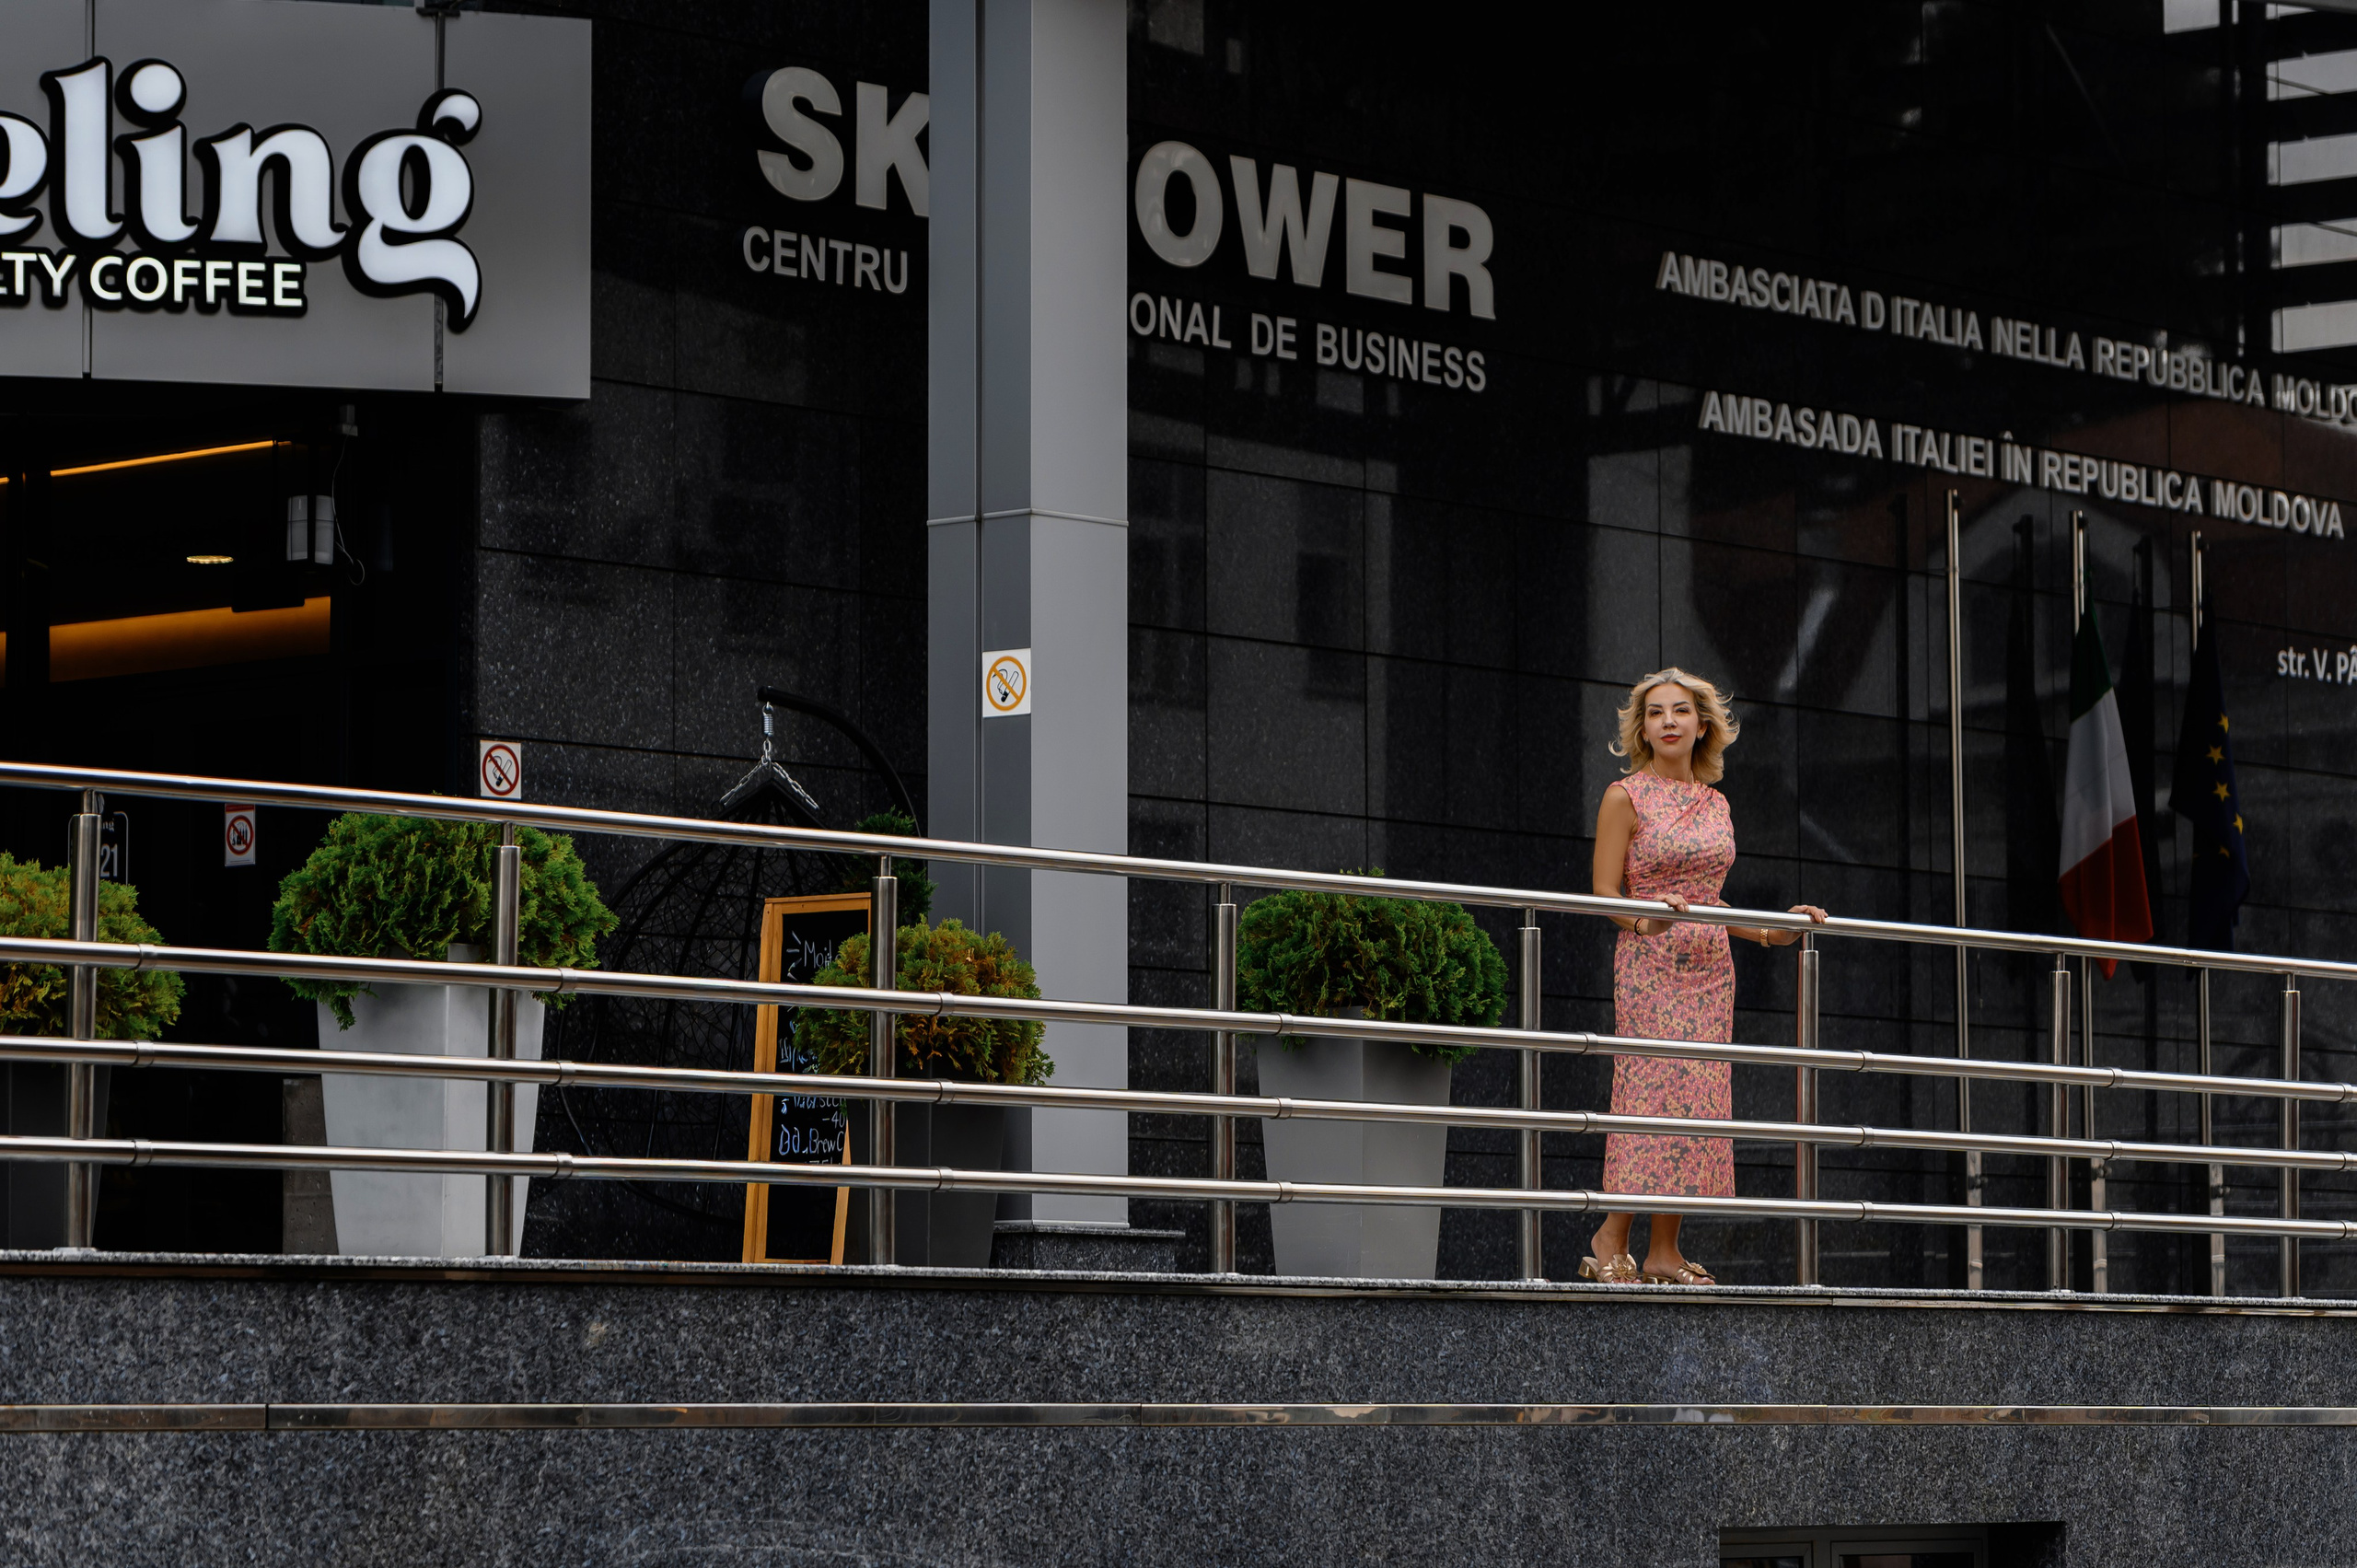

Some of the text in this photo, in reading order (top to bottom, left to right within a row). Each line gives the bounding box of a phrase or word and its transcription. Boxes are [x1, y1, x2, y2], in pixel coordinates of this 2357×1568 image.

[0, 252, 304, 308] TY COFFEE
[742, 226, 1487, 393] CENTRU ONAL DE BUSINESS
[1655, 250, 1857, 326] AMBASCIATA
[1890, 295, 1984, 352] ITALIA
[1990, 315, 2086, 371] NELLA
[2091, 335, 2266, 408] REPUBBLICA
[1697, 389, 2345, 540] AMBASADA ITALIEI ÎN REPUBLICA MOLDOVA
[2277, 645, 2310, 679] str.
[2312, 646, 2332, 683] V.
